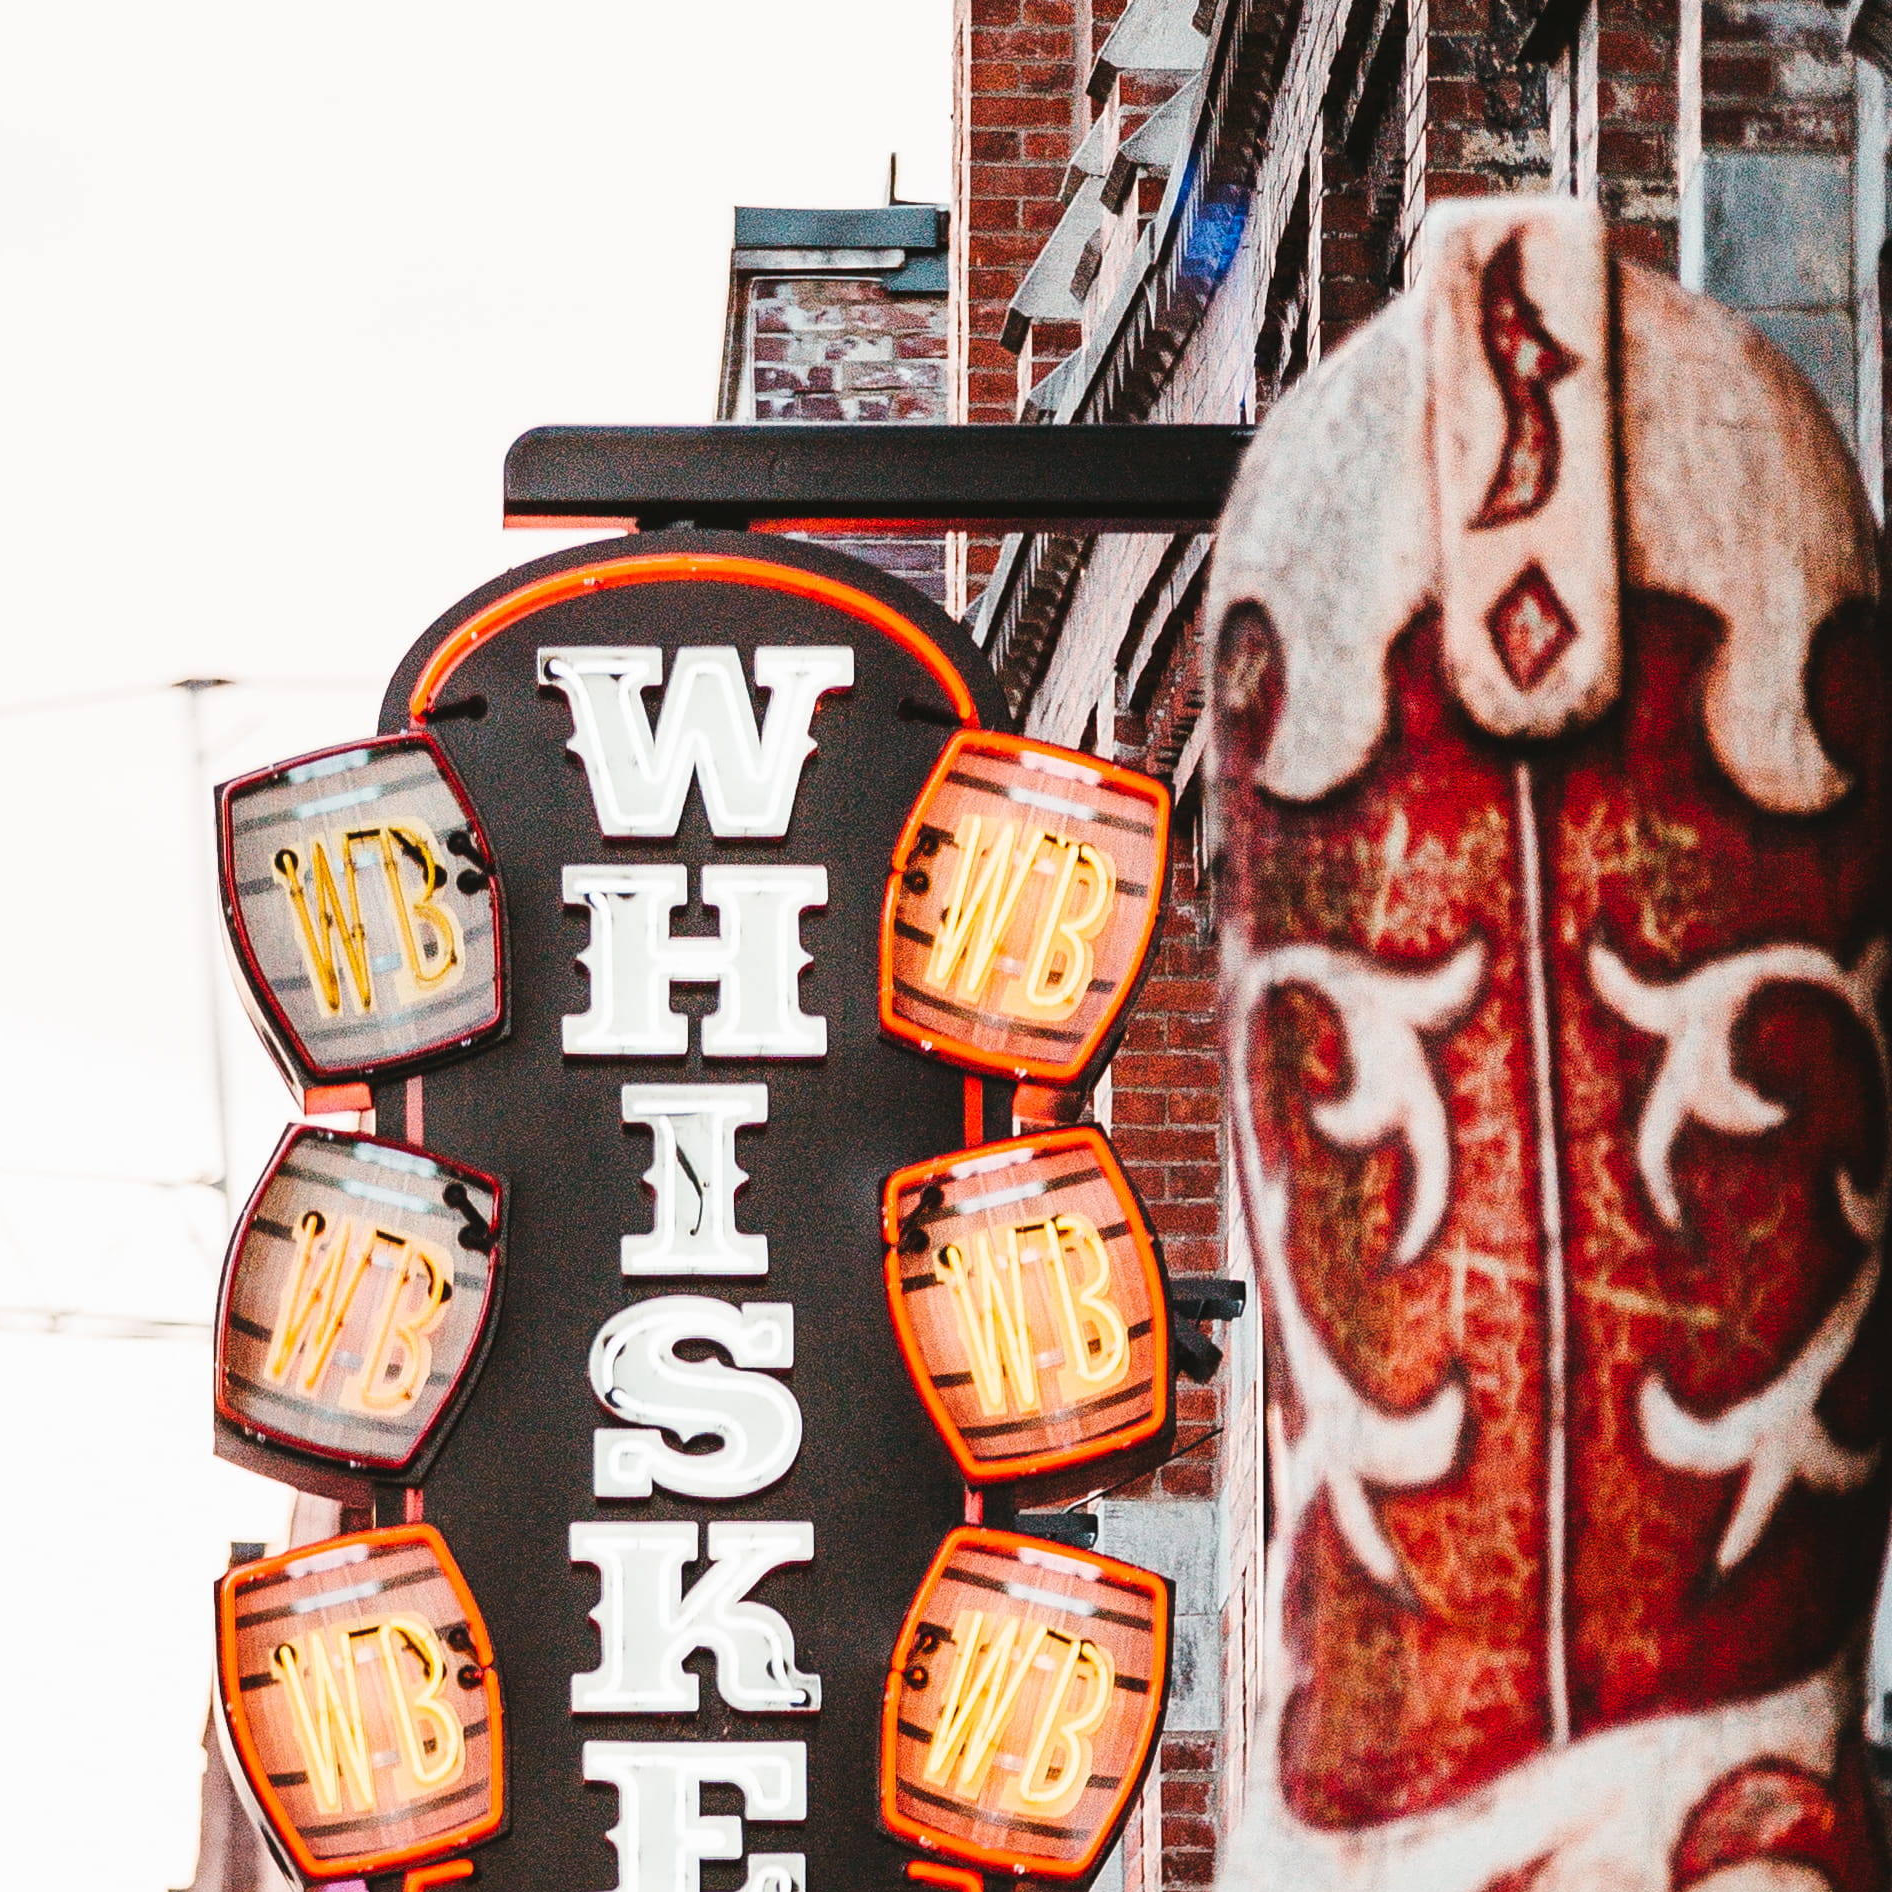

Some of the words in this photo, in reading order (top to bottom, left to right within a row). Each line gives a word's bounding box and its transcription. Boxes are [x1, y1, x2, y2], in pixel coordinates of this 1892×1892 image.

[274, 816, 465, 1018] WB
[928, 814, 1116, 1021] WB
[264, 1210, 456, 1418] WB
[934, 1213, 1131, 1417] WB
[276, 1614, 468, 1816] WB
[922, 1609, 1118, 1818] WB
